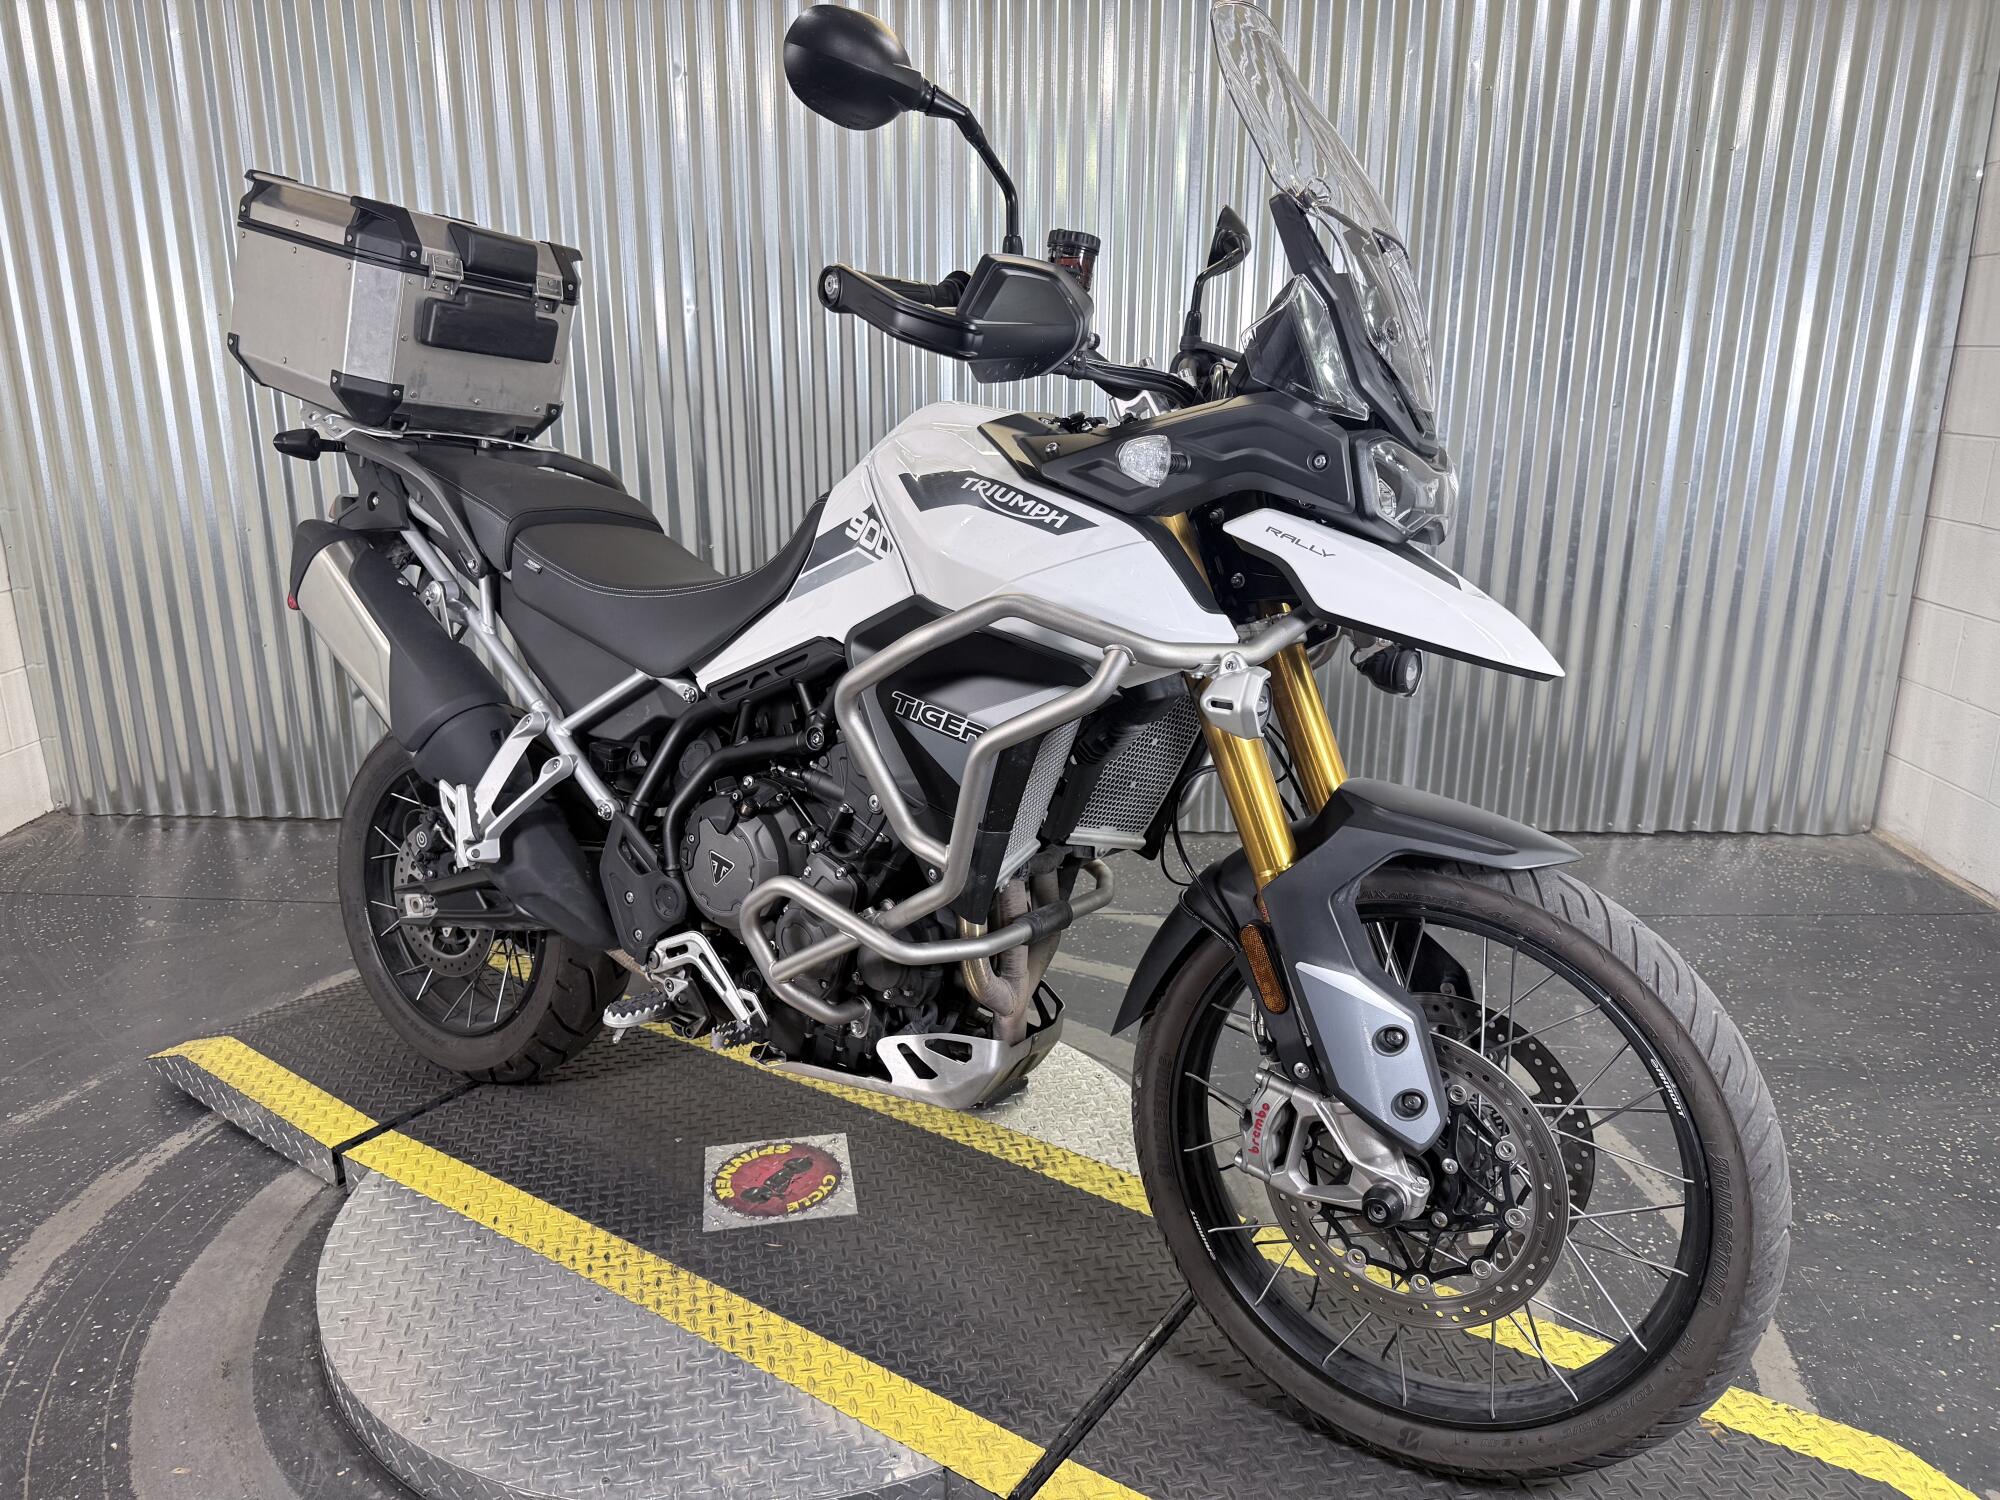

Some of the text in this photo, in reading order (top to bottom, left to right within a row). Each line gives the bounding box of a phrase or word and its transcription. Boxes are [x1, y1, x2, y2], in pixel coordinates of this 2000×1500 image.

[961, 477, 1069, 529] TRIUMPH
[1265, 526, 1336, 557] RALLY
[1248, 1102, 1271, 1156] brembo
[715, 1144, 793, 1200] SPINNER
[786, 1174, 837, 1213] CYCLE
[1704, 1153, 1734, 1306] BRIDGESTONE
